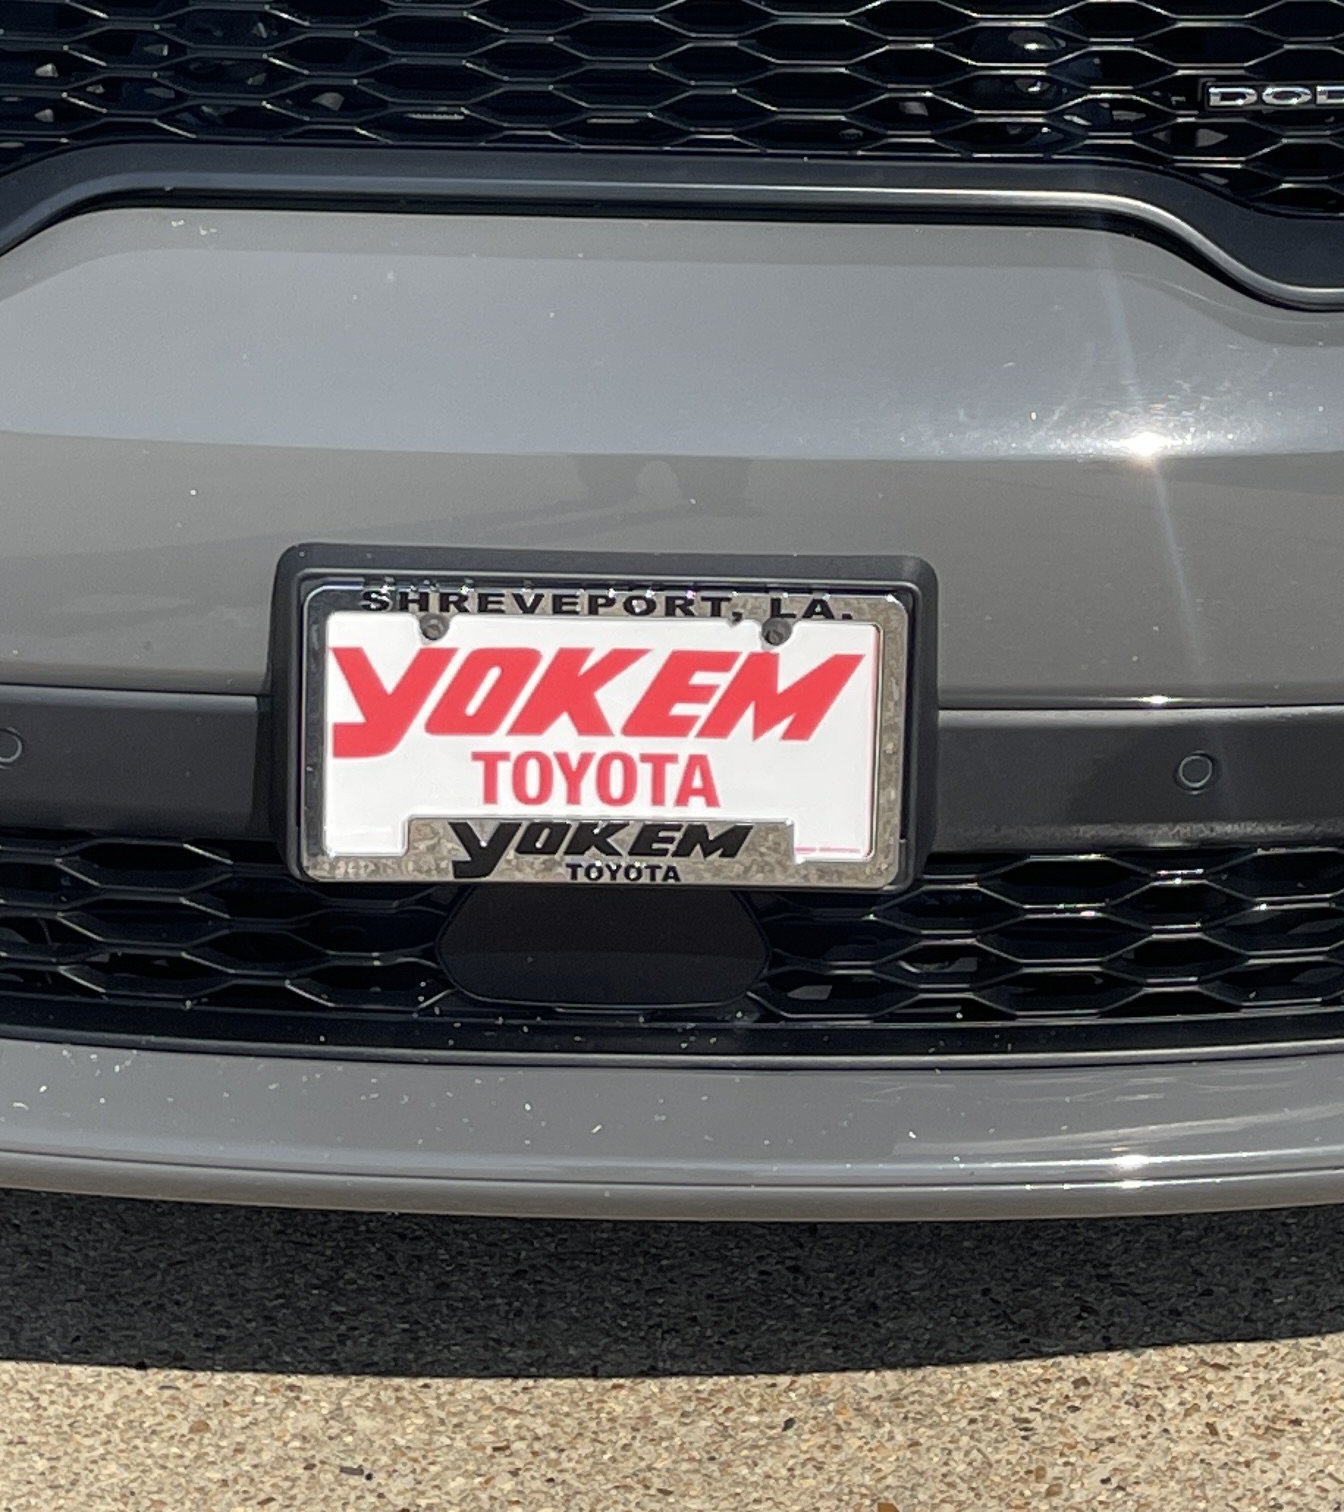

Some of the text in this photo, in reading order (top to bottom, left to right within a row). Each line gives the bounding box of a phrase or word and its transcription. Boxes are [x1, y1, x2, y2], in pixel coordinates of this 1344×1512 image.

[769, 592, 855, 620] LA.
[329, 646, 865, 759] YOKEM
[471, 751, 721, 809] TOYOTA
[448, 821, 754, 879] YOKEM
[565, 862, 682, 884] TOYOTA
